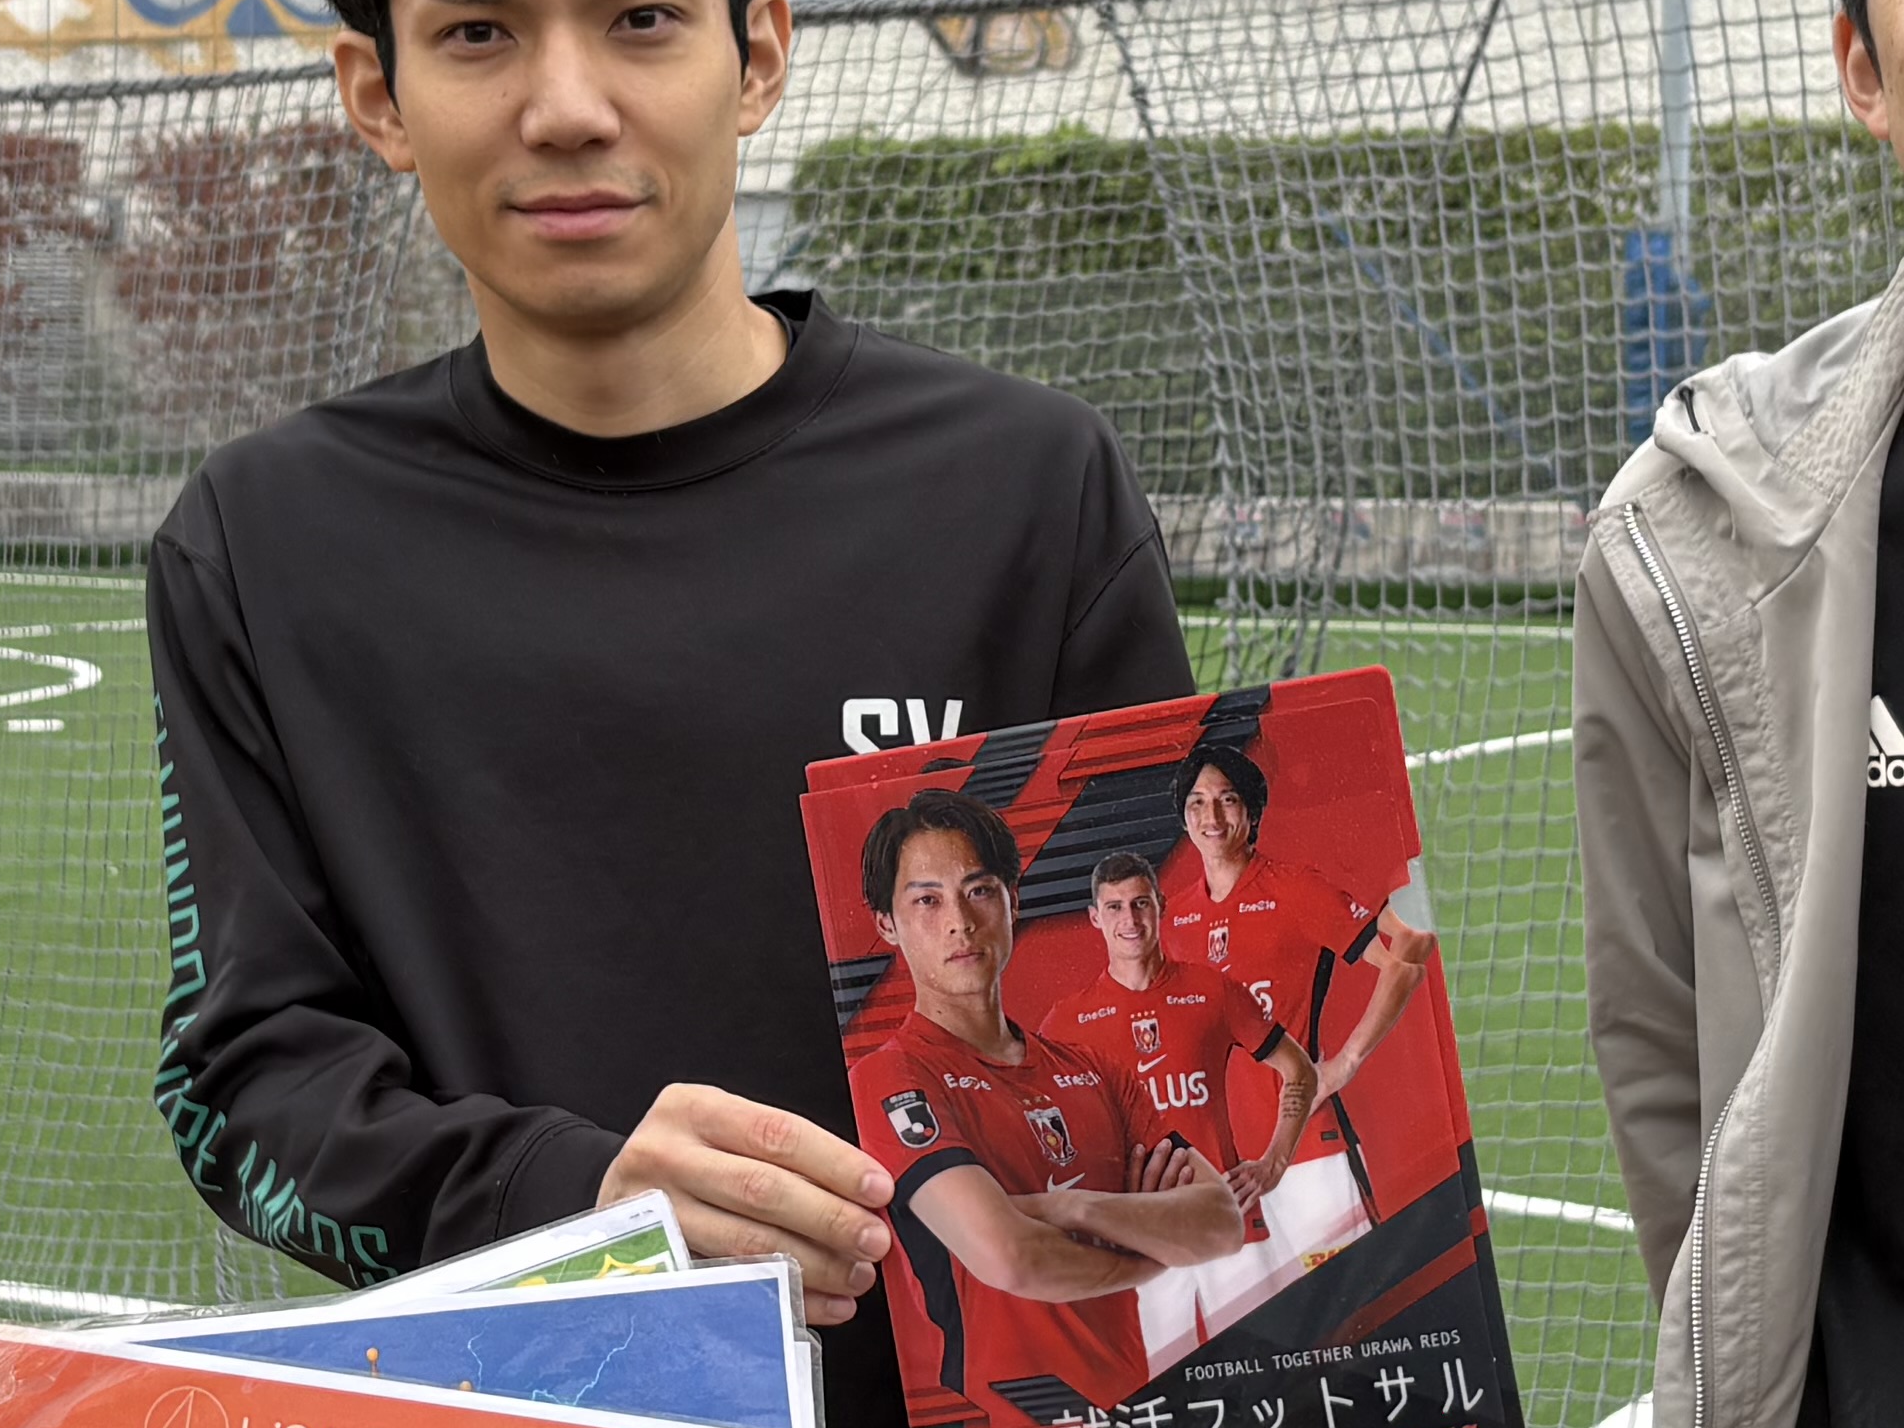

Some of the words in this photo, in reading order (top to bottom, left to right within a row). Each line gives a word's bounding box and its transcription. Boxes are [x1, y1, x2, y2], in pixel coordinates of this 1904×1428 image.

[1140, 1070, 1210, 1112] LUS
[1184, 1358, 1265, 1382] FOOTBALL
[1271, 1344, 1355, 1370] TOGETHER
[1360, 1336, 1413, 1358] URAWA
[1419, 1328, 1463, 1350] REDS
